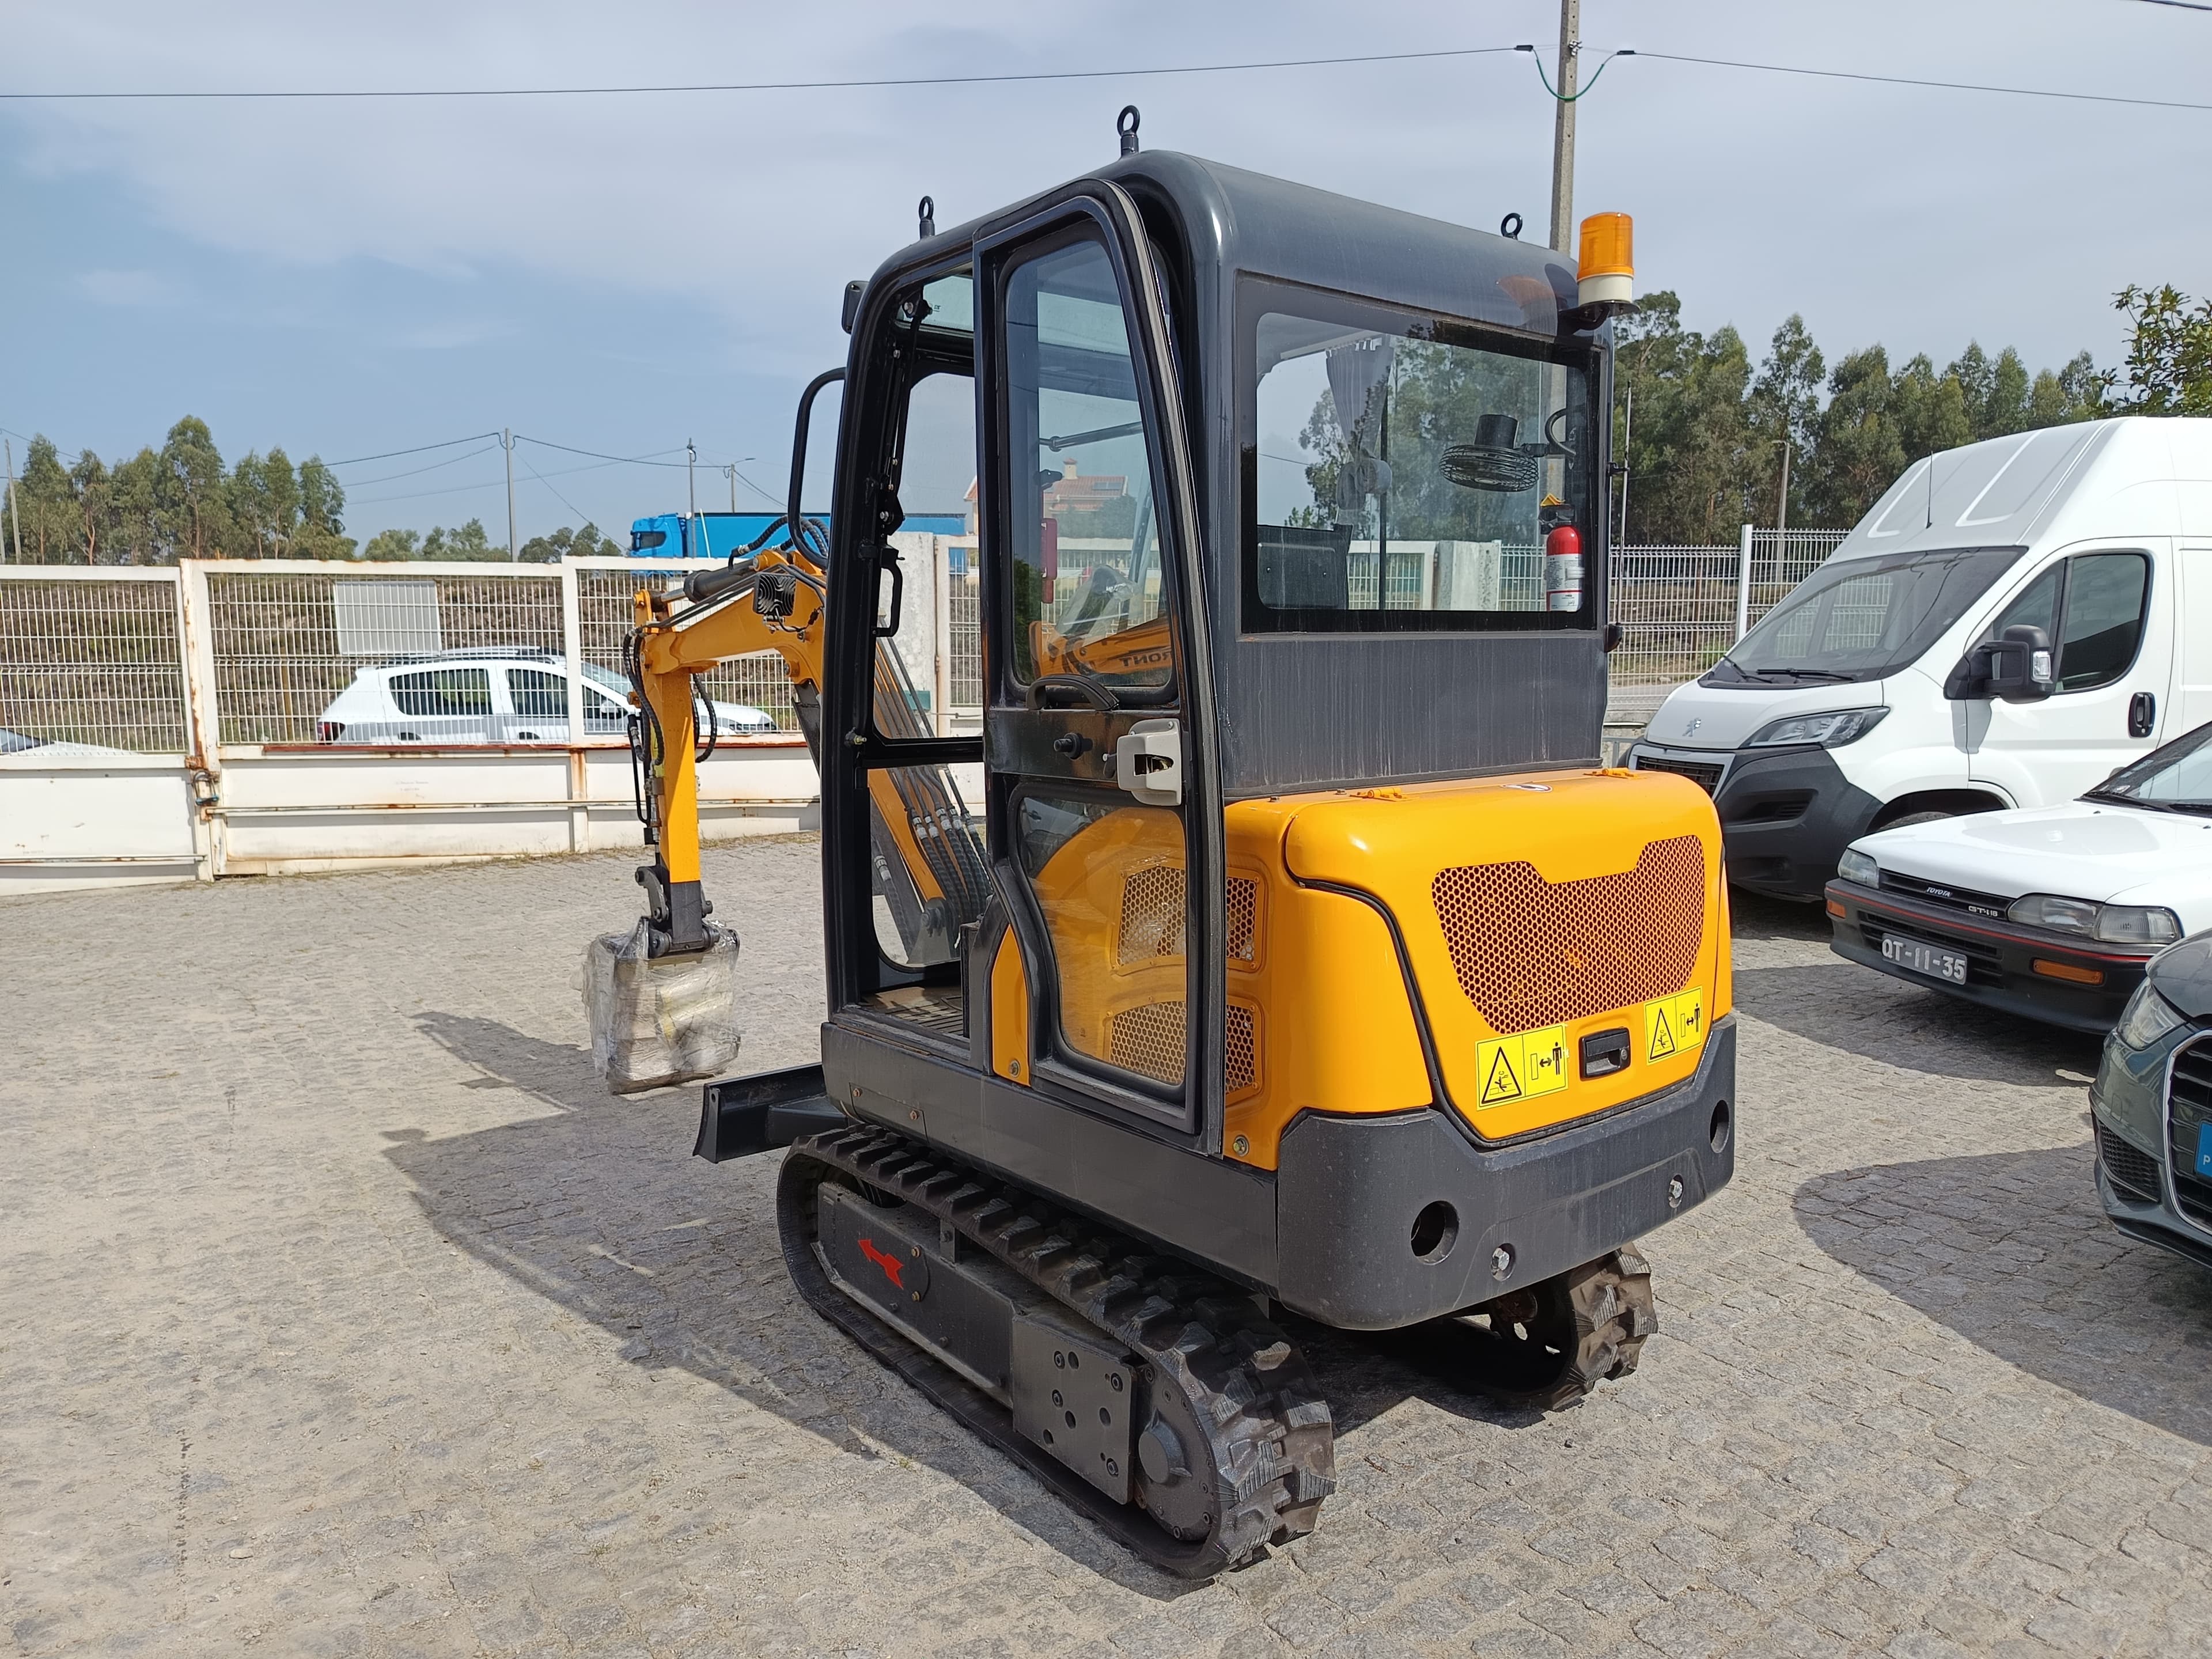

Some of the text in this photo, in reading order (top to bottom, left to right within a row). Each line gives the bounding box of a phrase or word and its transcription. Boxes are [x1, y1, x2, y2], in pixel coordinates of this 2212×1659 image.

[1926, 887, 1950, 897] TOYOTA
[1882, 939, 1965, 979] QT-11-35
[2203, 1154, 2211, 1165] P
